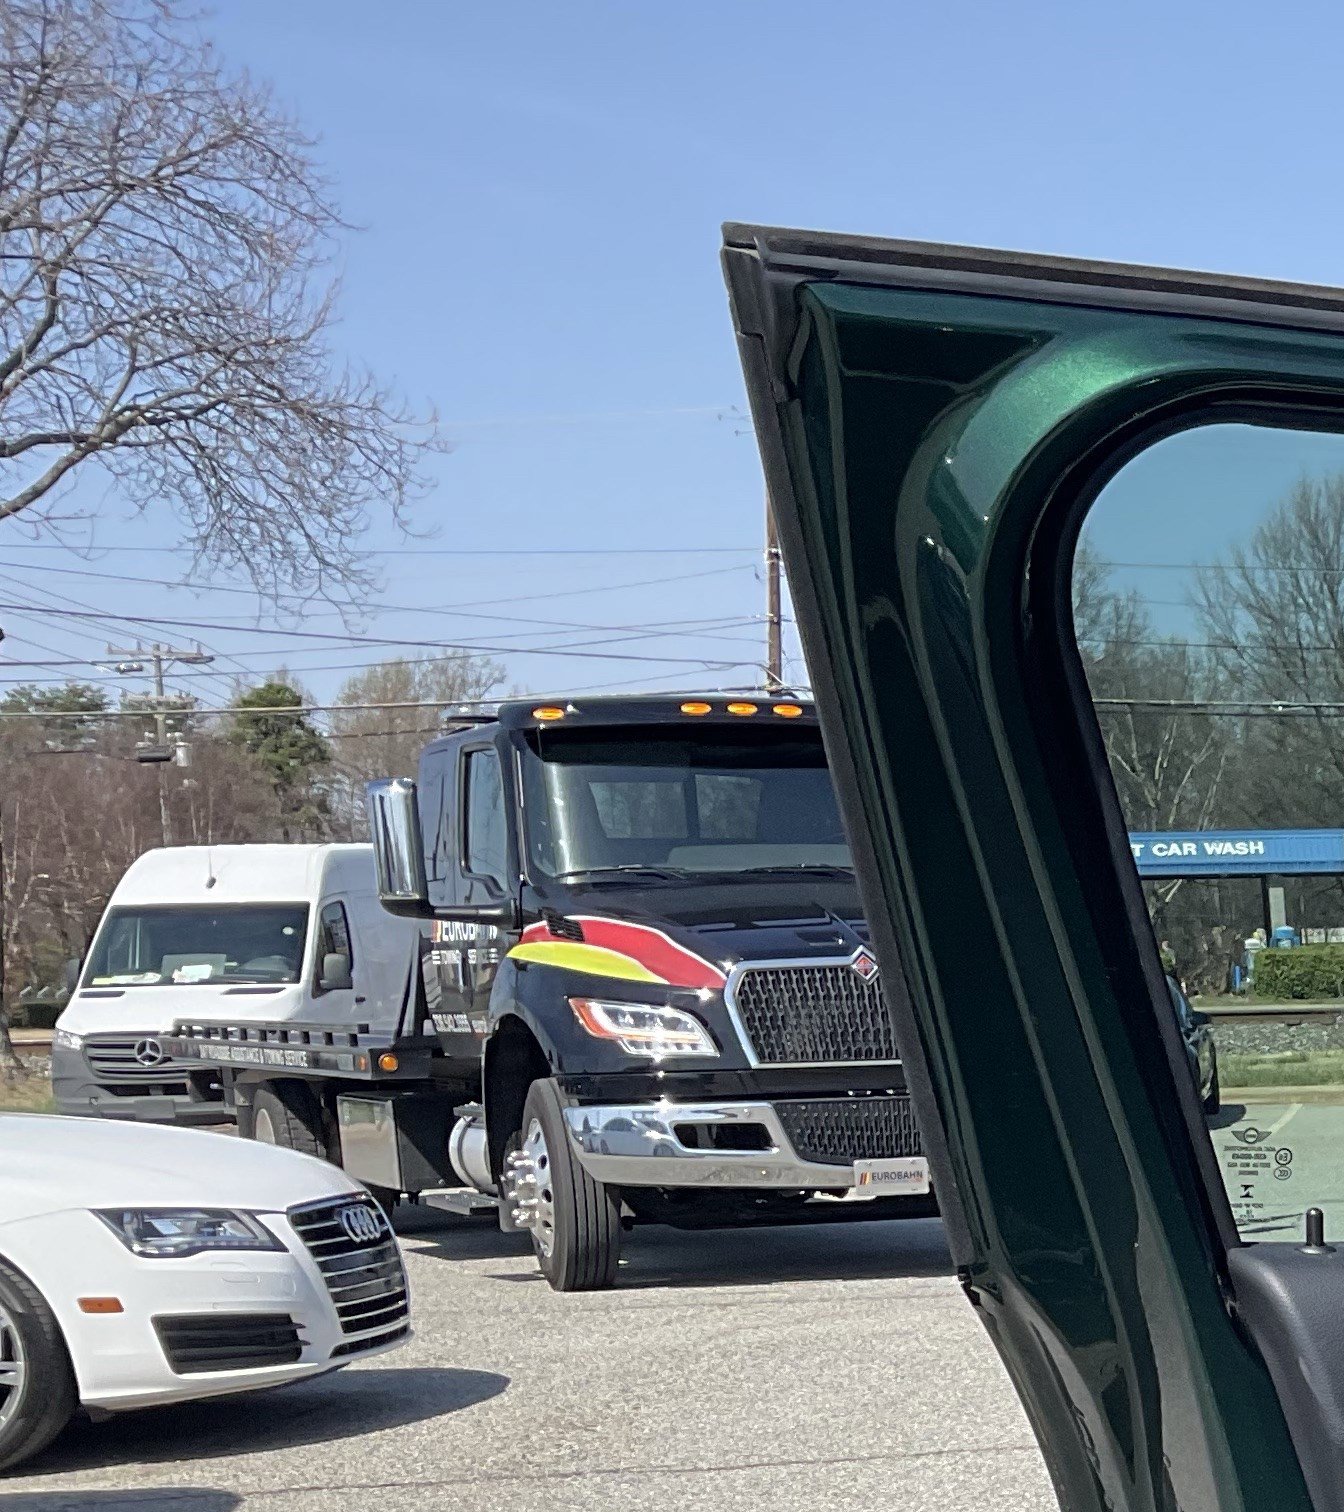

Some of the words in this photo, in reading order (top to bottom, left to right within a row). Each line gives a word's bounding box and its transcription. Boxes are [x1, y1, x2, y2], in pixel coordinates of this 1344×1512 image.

[1152, 842, 1197, 857] CAR
[1204, 840, 1265, 855] WASH
[872, 1171, 923, 1181] EUROBAHN
